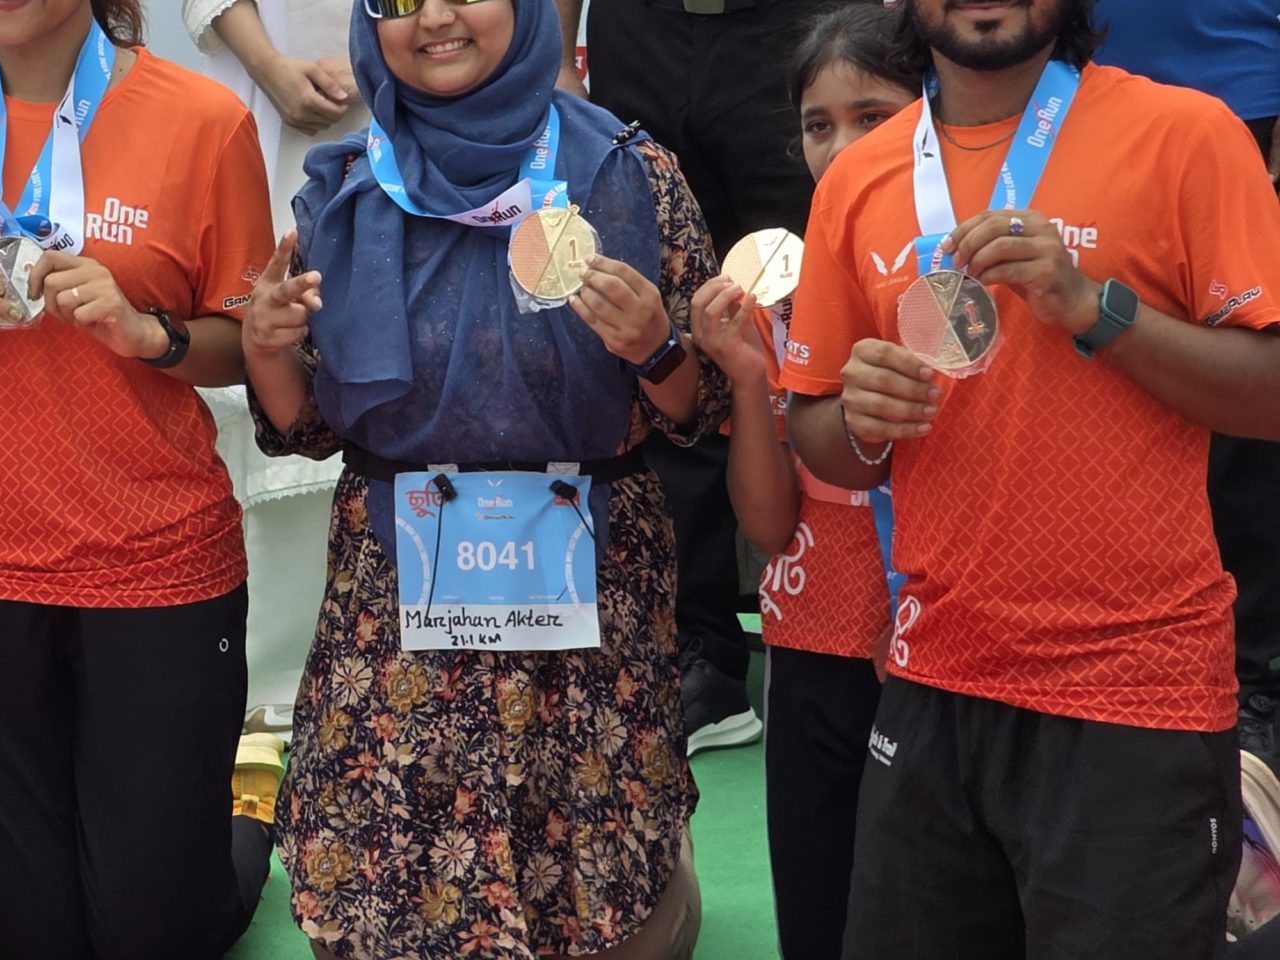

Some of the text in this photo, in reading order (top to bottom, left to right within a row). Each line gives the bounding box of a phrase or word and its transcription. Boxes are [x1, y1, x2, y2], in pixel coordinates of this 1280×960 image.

[104, 197, 149, 229] One
[86, 213, 133, 246] Run
[782, 254, 790, 272] 1
[457, 541, 535, 571] 8041
